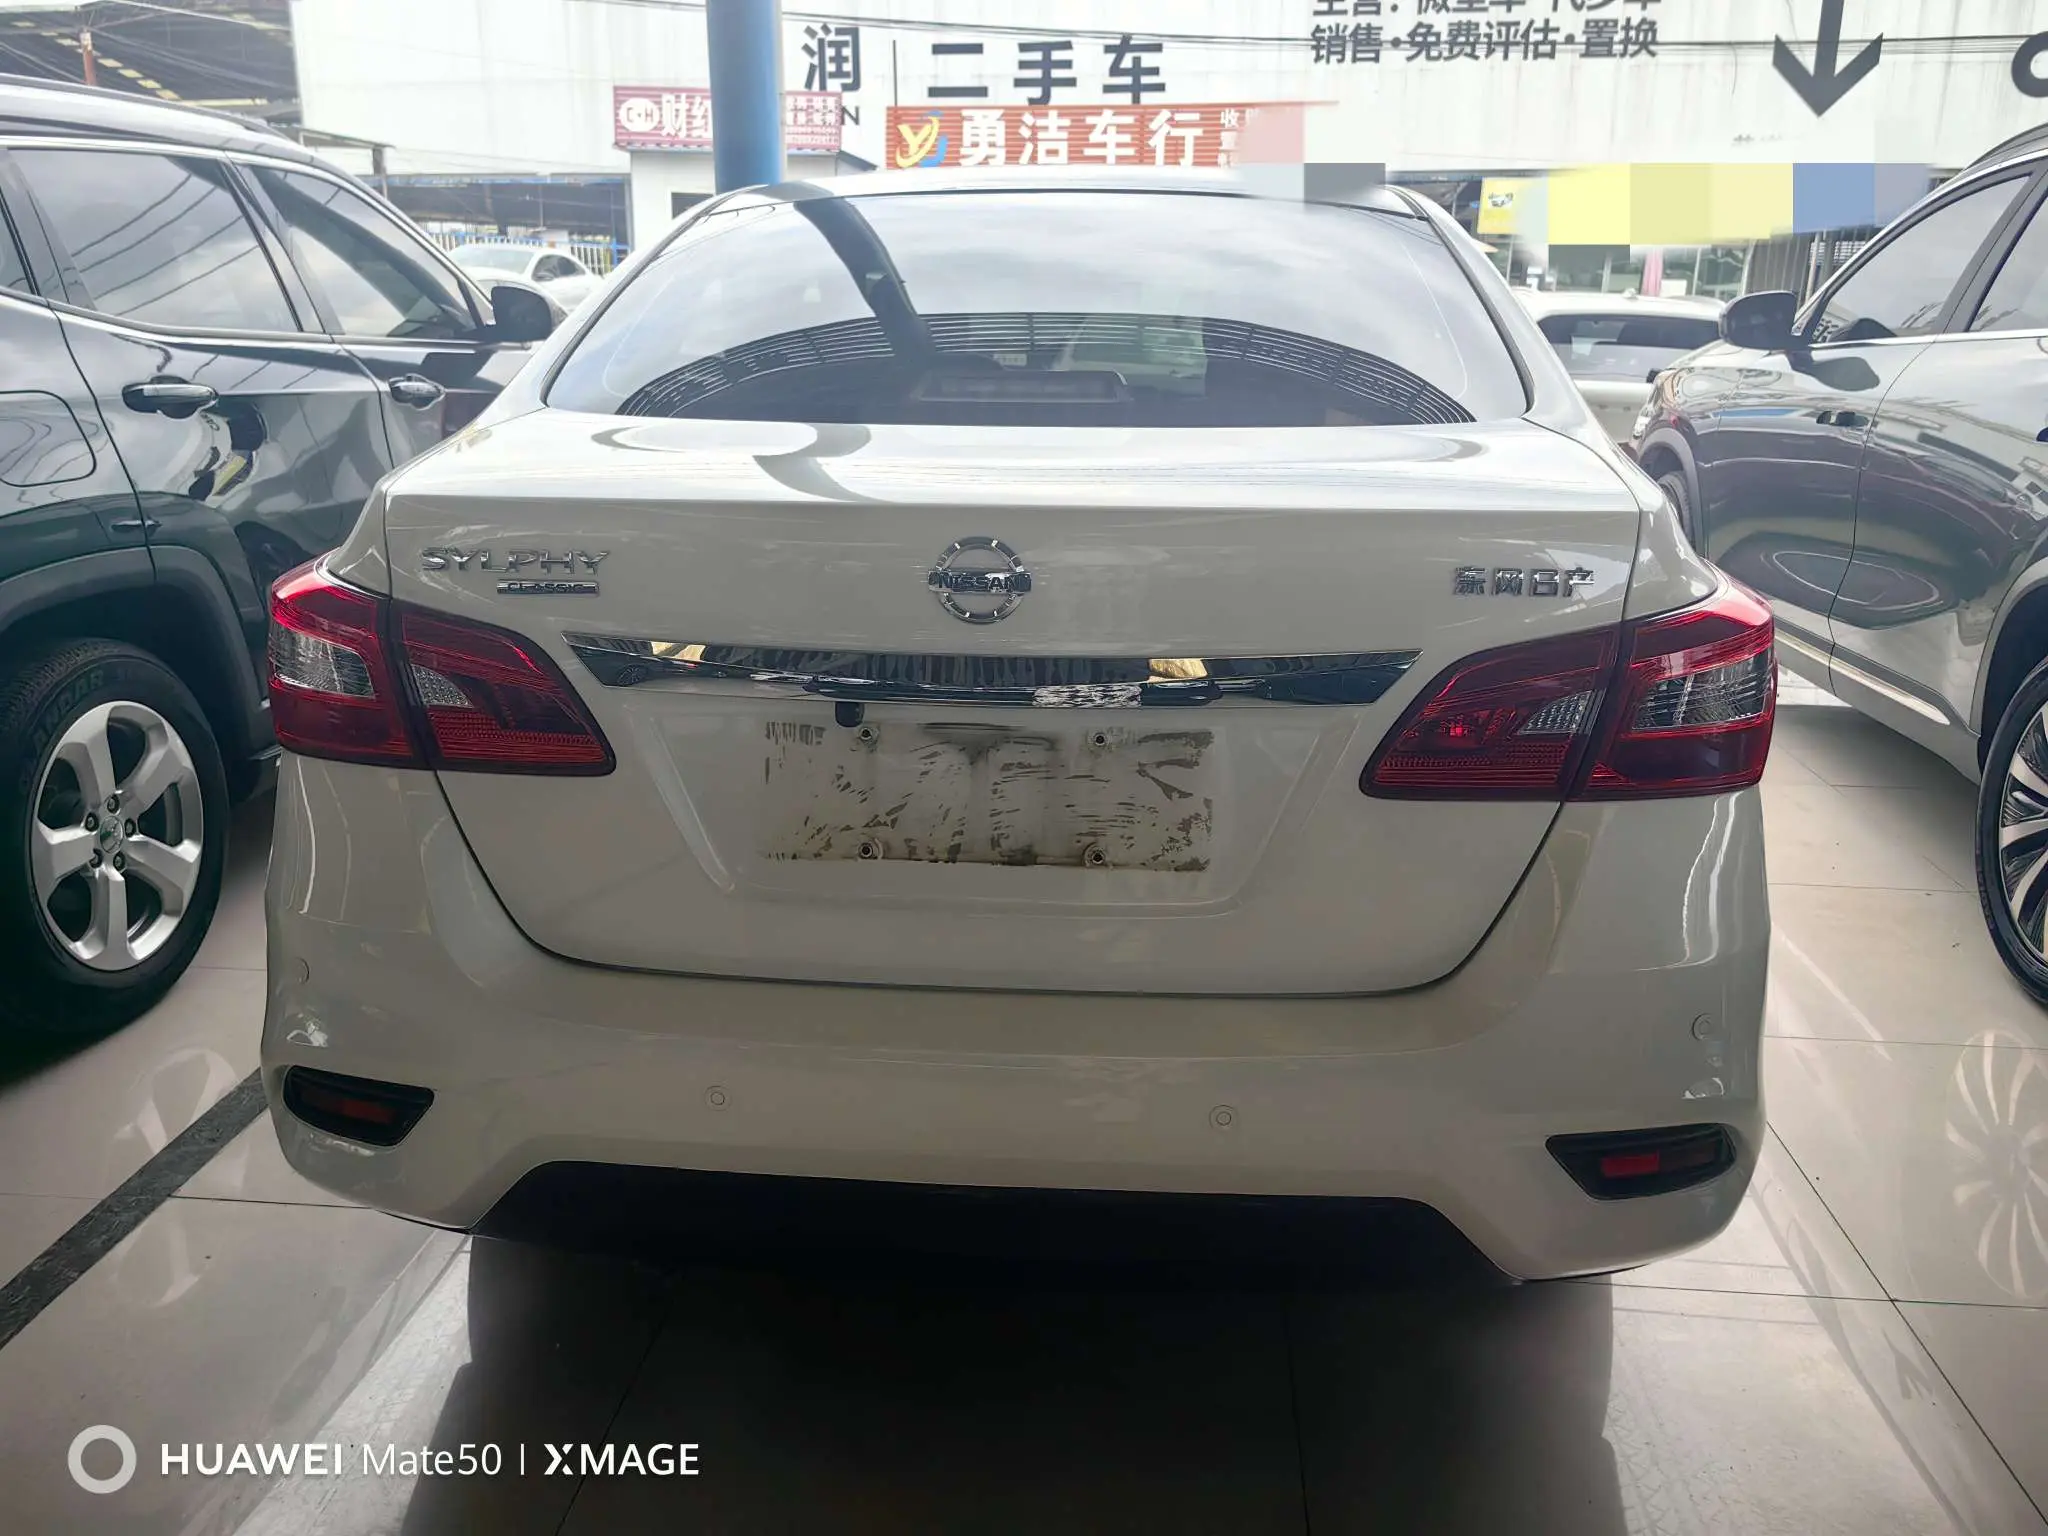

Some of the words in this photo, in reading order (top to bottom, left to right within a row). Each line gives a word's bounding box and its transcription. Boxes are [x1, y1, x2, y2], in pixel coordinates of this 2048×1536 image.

[801, 23, 861, 92] 润
[927, 33, 1166, 105] 二手车
[958, 108, 1203, 166] 勇洁车行
[420, 547, 611, 576] SYLPHY
[1454, 566, 1596, 597] 东风日产
